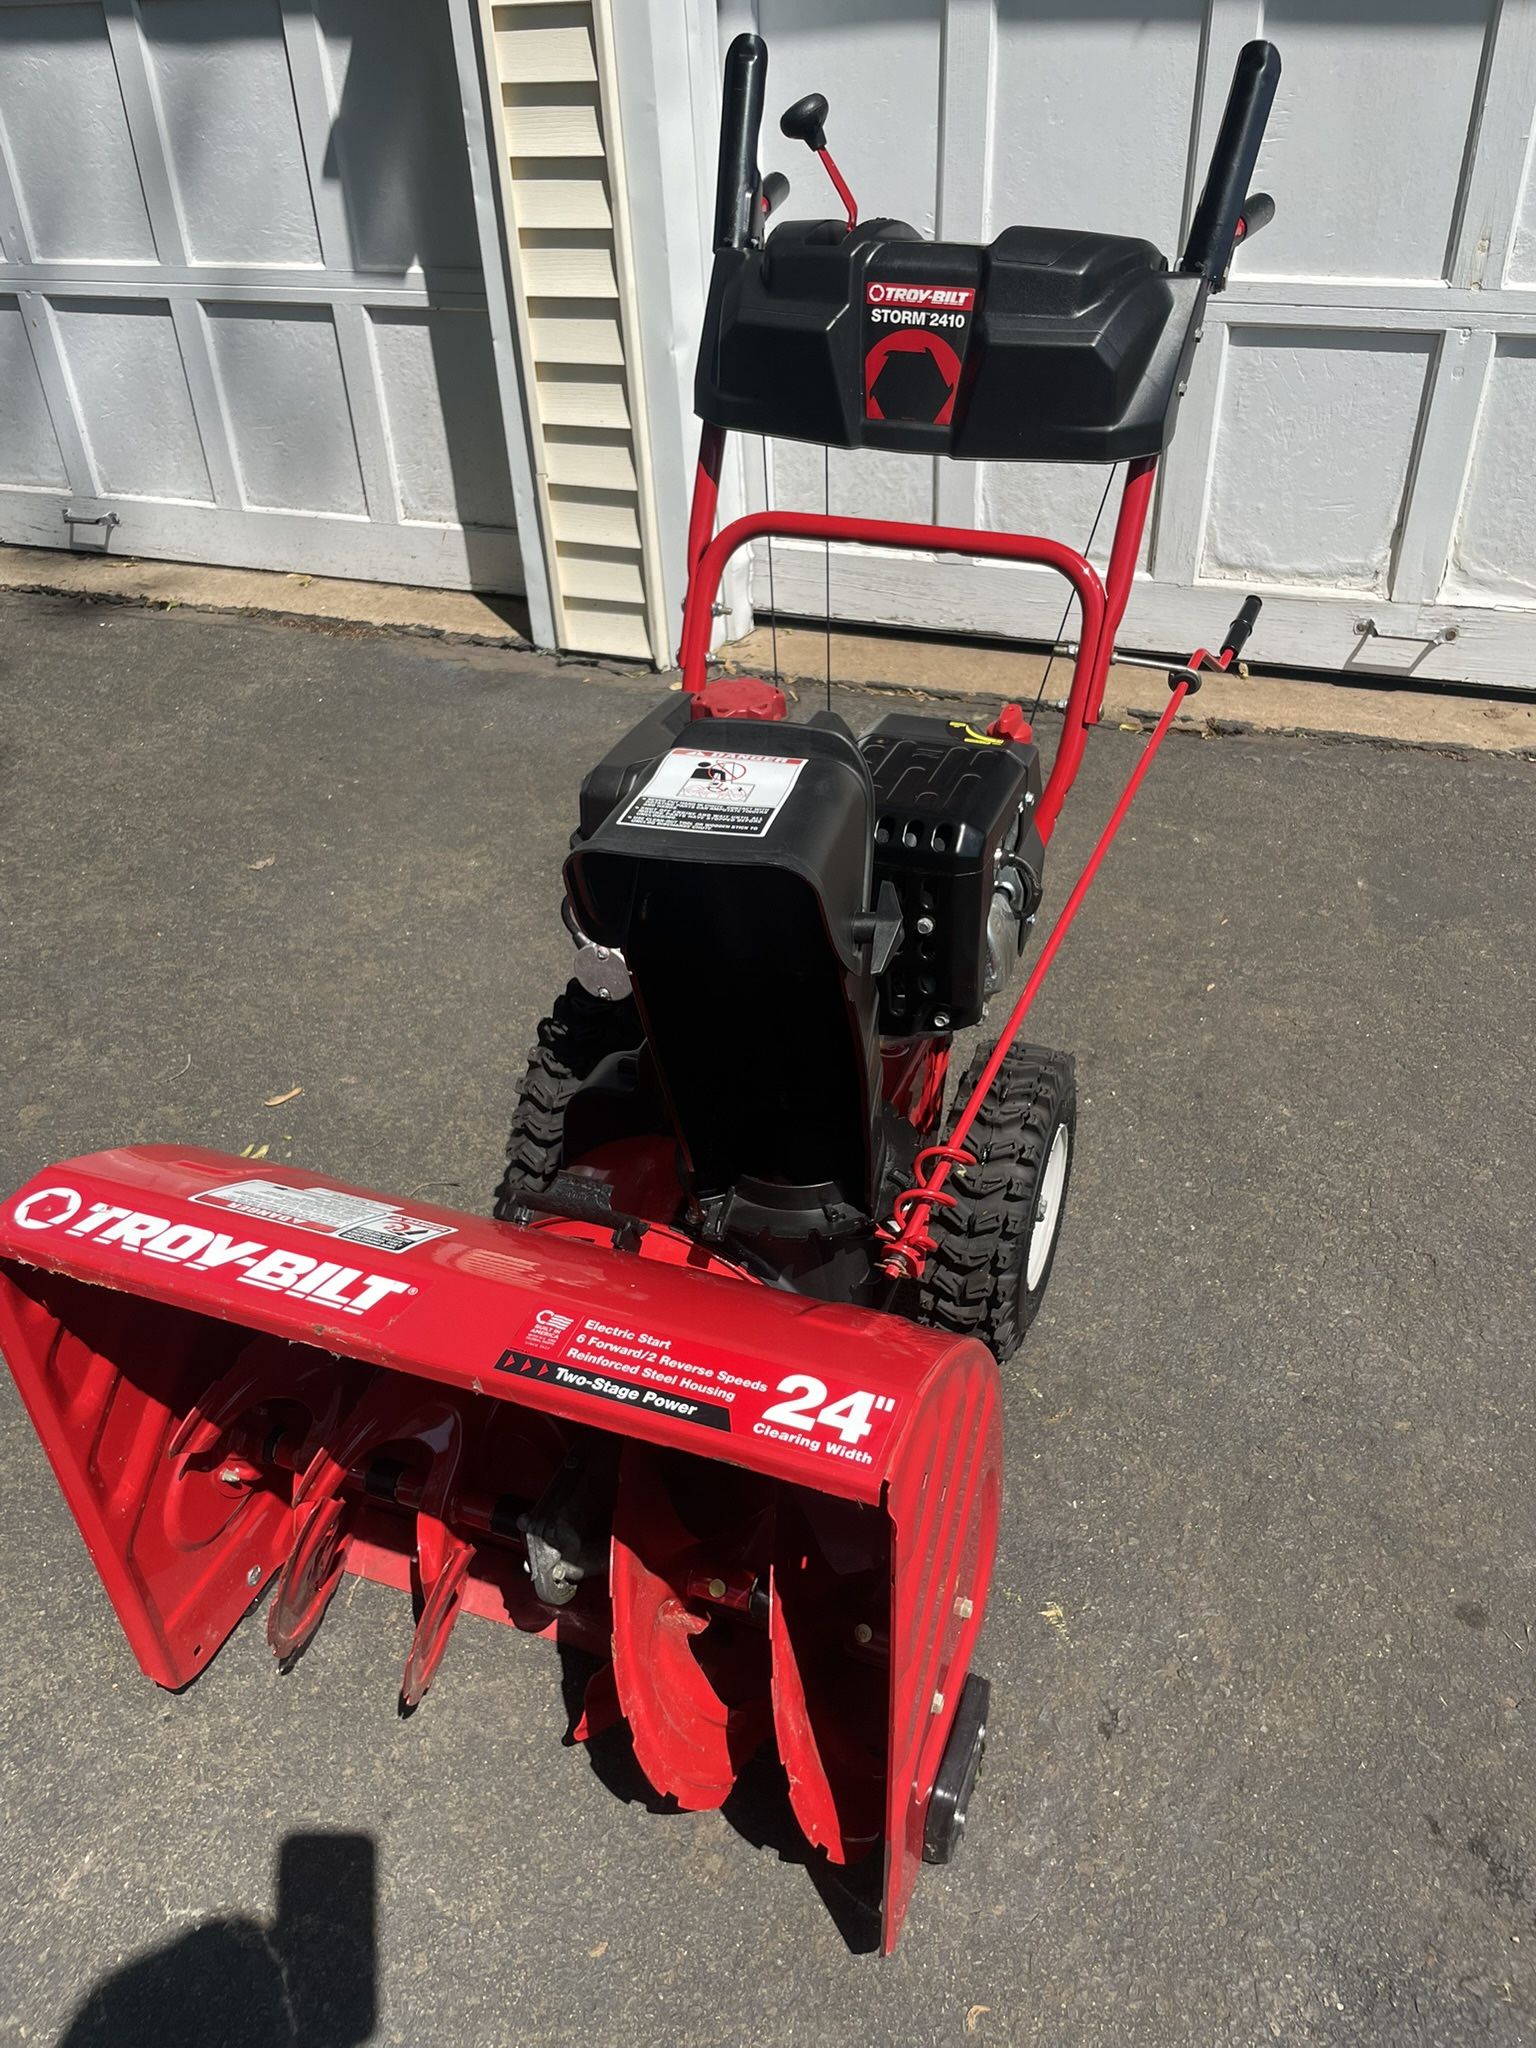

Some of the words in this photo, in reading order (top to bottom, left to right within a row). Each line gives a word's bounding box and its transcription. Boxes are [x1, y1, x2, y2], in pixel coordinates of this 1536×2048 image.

[885, 287, 970, 306] TROY-BILT
[929, 312, 965, 328] 2410
[711, 752, 787, 764] DANGER
[227, 1202, 292, 1220] DANGER
[584, 1319, 635, 1341] Electric
[637, 1333, 672, 1349] Start
[567, 1347, 639, 1375] Reinforced
[641, 1367, 677, 1385] Steel
[678, 1377, 736, 1402] Housing
[576, 1333, 586, 1343] 6
[587, 1337, 655, 1362] Forward/2
[659, 1355, 715, 1377] Reverse
[717, 1370, 768, 1392] Speeds
[555, 1367, 639, 1400] Two-Stage
[642, 1391, 698, 1416] Power
[761, 1374, 896, 1444] 24"
[753, 1422, 821, 1451] Clearing
[826, 1442, 873, 1464] Width
